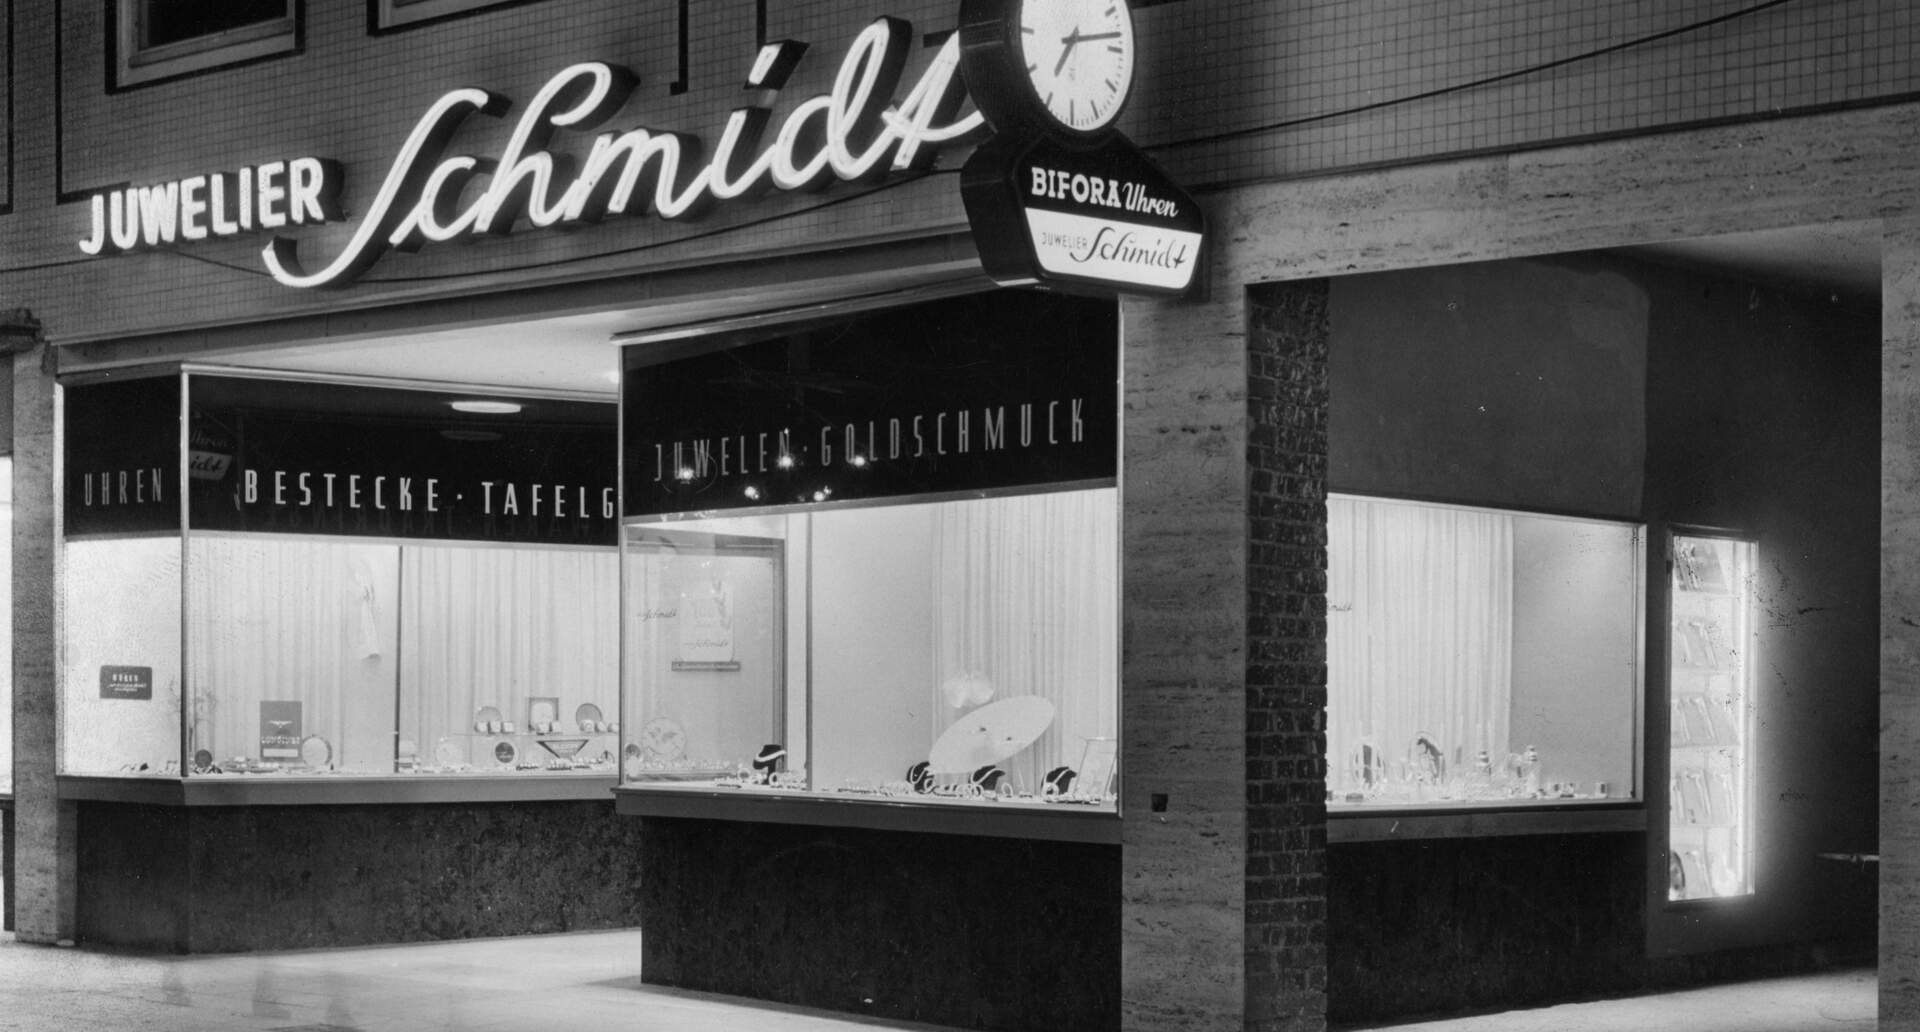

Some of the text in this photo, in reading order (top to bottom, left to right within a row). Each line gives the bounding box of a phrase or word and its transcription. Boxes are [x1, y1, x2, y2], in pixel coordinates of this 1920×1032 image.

[79, 17, 987, 288] JUWELIER Schmidt
[1030, 166, 1179, 218] BIFORA Uhren
[1041, 226, 1187, 269] JUWELIER Schmidt
[653, 398, 1084, 482] JUWELEN GOLDSCHMUCK
[84, 467, 162, 507] UHREN
[244, 469, 614, 519] BESTECKE TAFELG
